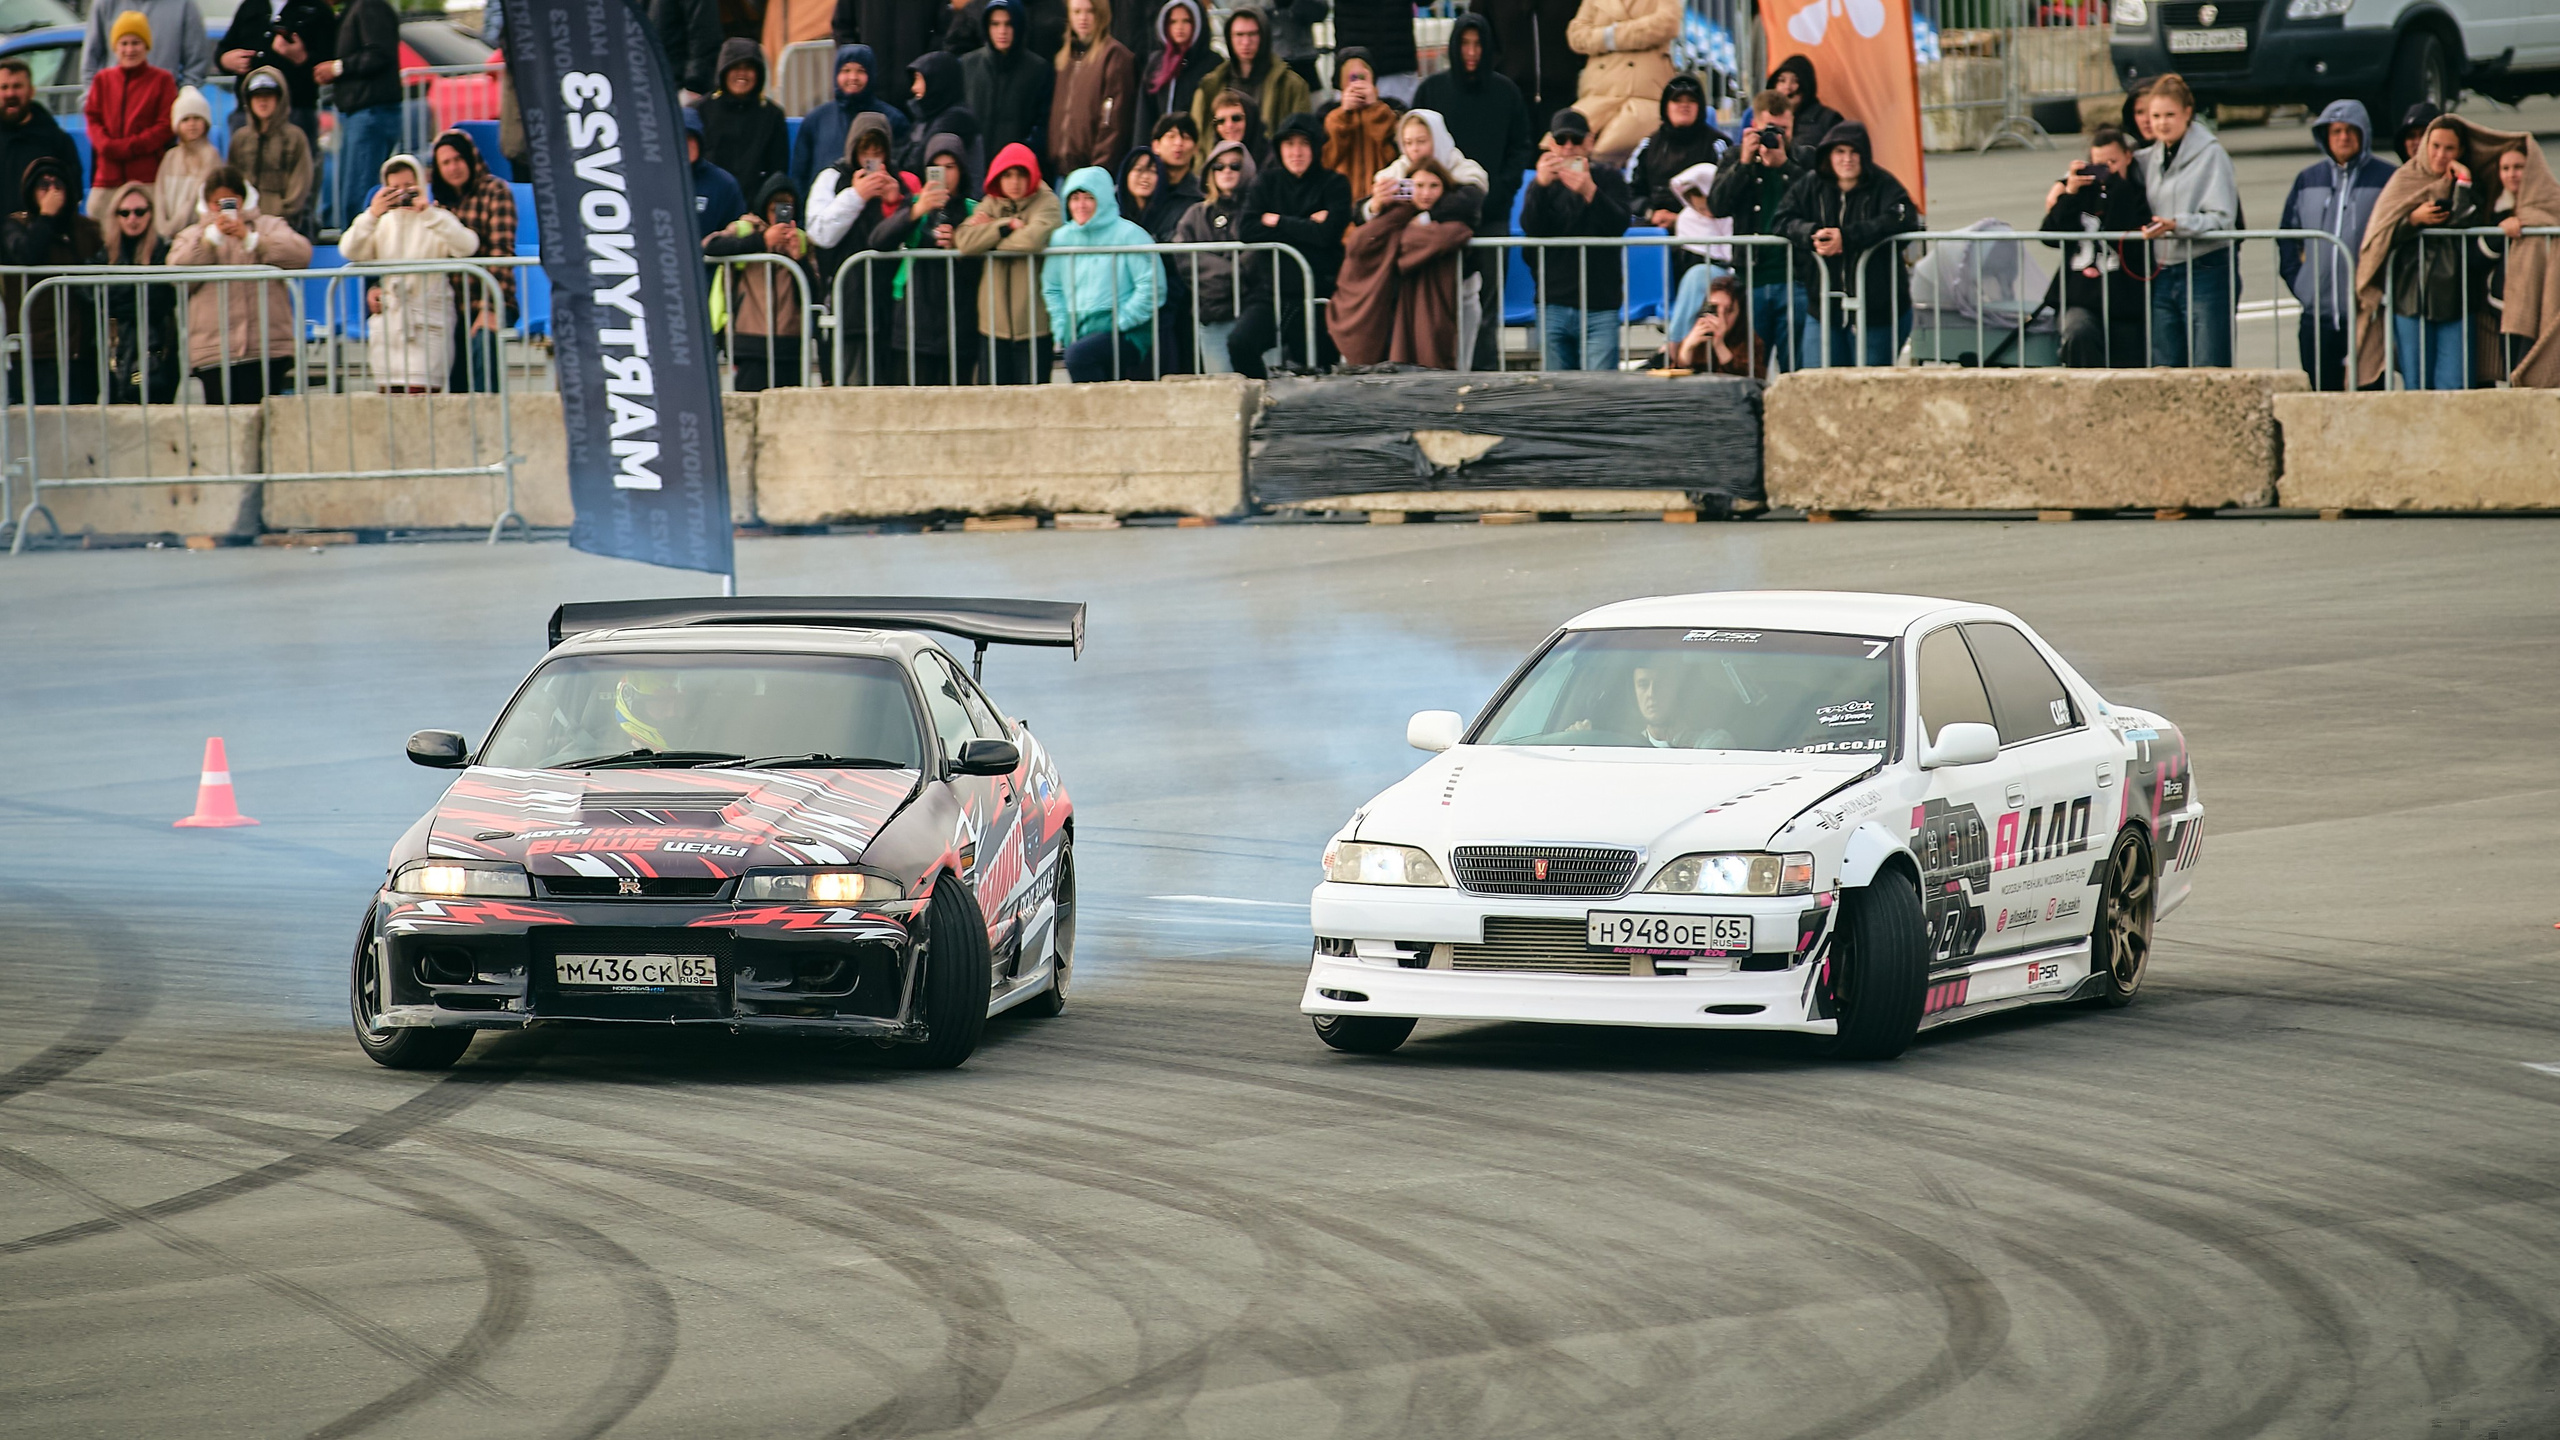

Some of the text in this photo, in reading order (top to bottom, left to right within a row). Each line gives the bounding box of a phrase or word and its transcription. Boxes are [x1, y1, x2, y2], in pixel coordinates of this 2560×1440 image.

[1863, 640, 1889, 660] 7
[590, 828, 766, 845] КАЧЕСТВО
[525, 838, 749, 858] ВЫШЕ ЦЕНЫ
[1715, 920, 1741, 939] 65
[1713, 939, 1732, 947] RUS
[682, 959, 706, 977] 65
[680, 976, 699, 984] RUS
